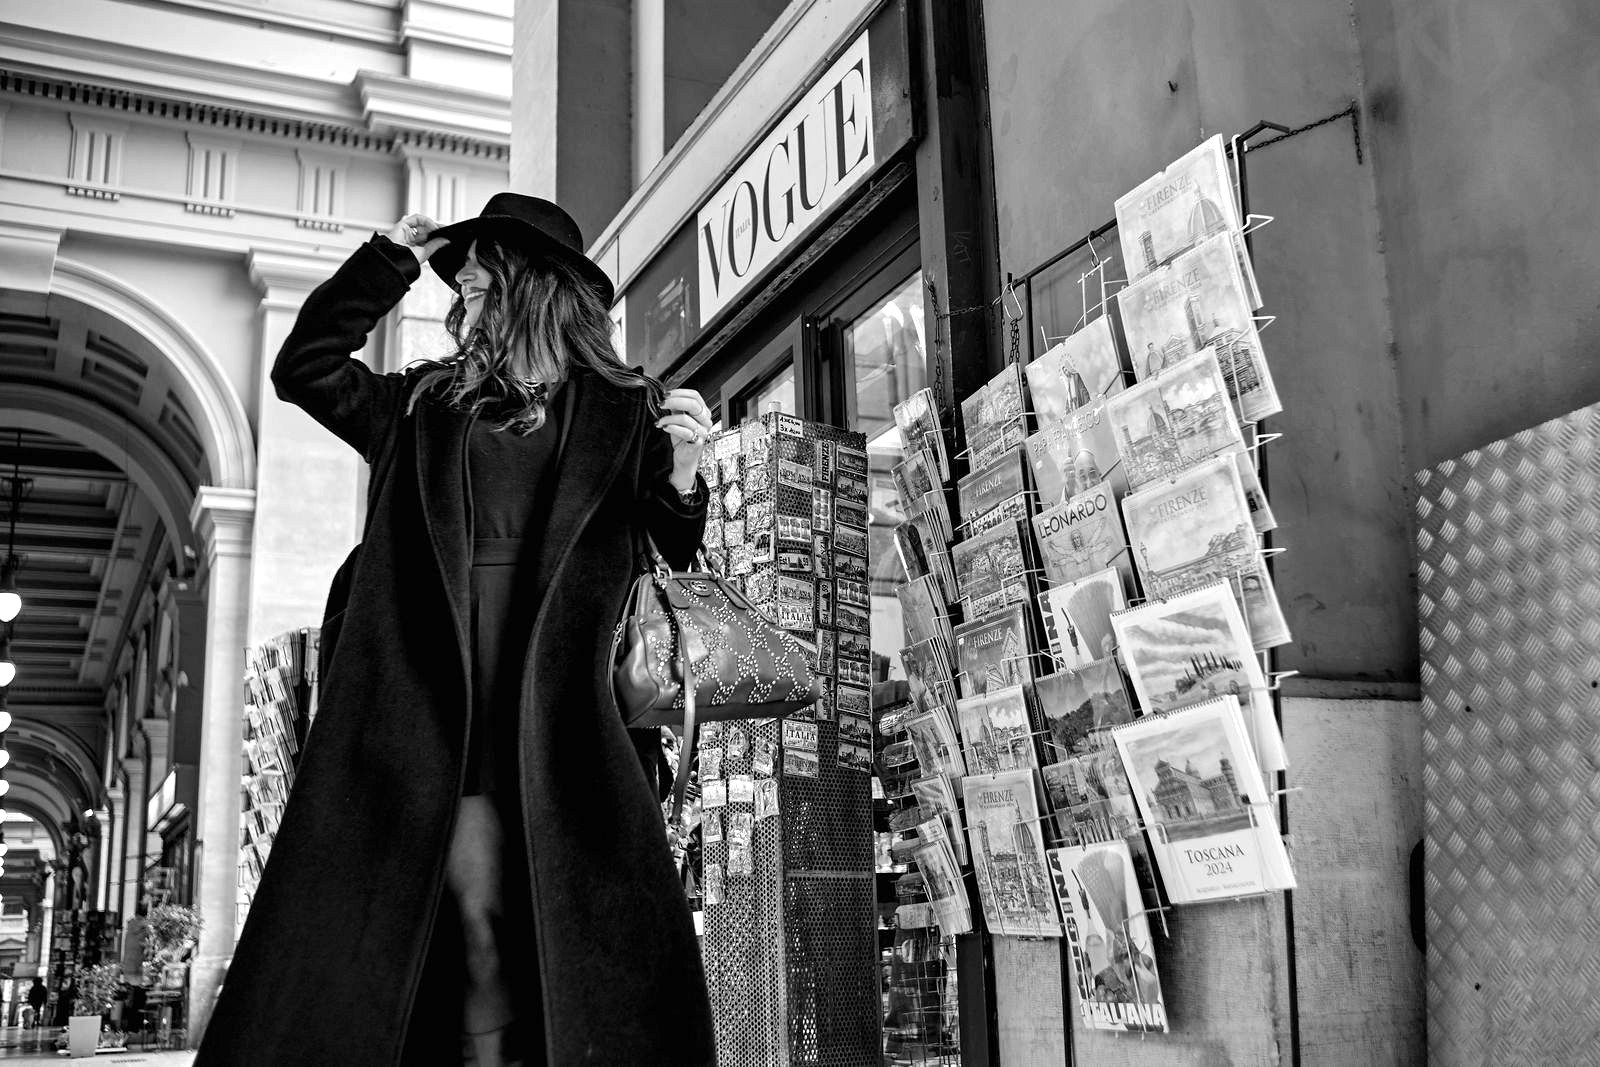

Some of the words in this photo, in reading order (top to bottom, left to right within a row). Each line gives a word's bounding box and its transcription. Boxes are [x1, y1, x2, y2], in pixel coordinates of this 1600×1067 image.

[701, 57, 869, 299] VOGUE
[1146, 175, 1192, 210] FIRENZE
[1152, 267, 1200, 305] FIRENZE
[821, 441, 830, 481] FIRENZE
[975, 473, 1002, 498] FIRENZE
[1158, 486, 1207, 521] FIRENZE
[1038, 494, 1107, 539] LEONARDO
[781, 610, 811, 622] ITALIA
[973, 627, 1003, 648] FIRENZE
[785, 729, 815, 741] ITALIA
[983, 789, 1014, 804] FIRENZE
[1184, 844, 1245, 864] TOSCANA
[1205, 861, 1233, 876] 2024
